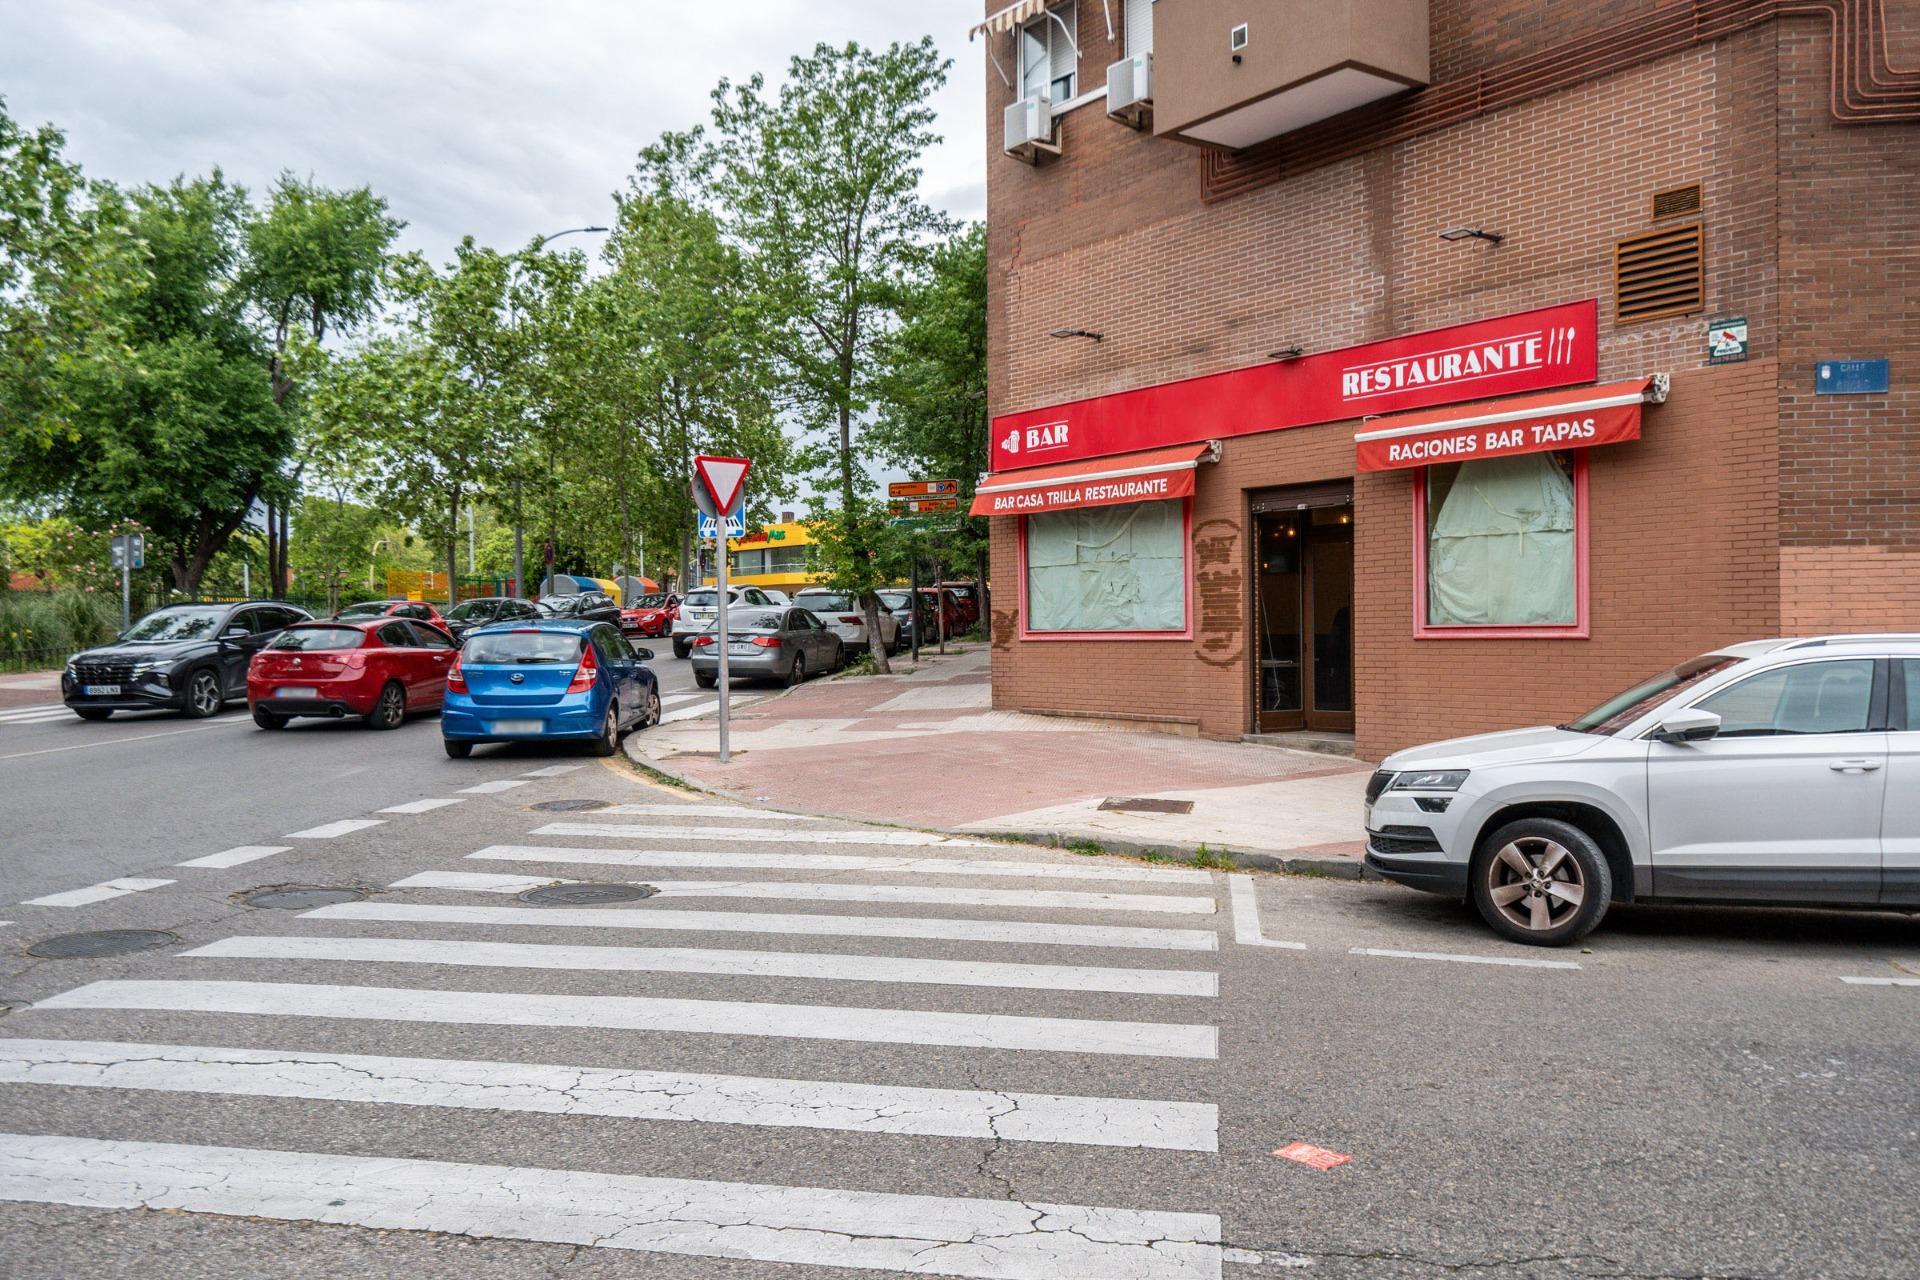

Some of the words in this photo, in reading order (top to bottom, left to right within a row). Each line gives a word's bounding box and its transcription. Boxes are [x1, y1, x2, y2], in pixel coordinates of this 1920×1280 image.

[1342, 337, 1543, 397] RESTAURANTE
[1026, 424, 1069, 450] BAR
[1389, 434, 1478, 462] RACIONES
[1485, 429, 1525, 451] BAR
[1531, 418, 1596, 444] TAPAS
[994, 494, 1015, 511] BAR
[1016, 490, 1044, 509] CASA
[1046, 487, 1082, 505] TRILLA
[1084, 478, 1168, 502] RESTAURANTE
